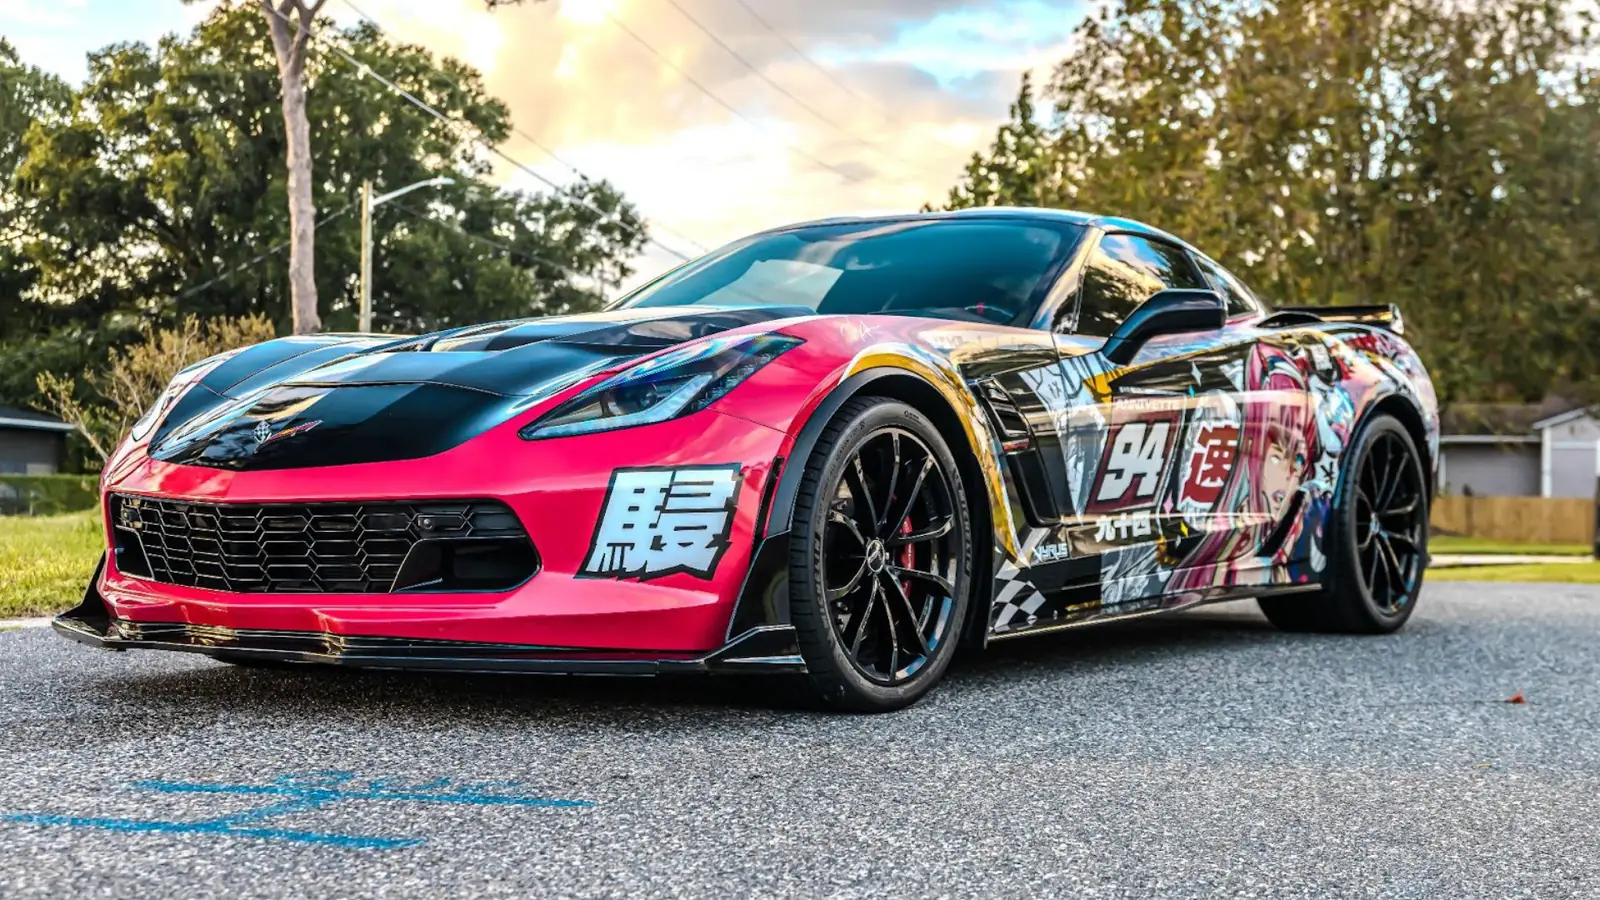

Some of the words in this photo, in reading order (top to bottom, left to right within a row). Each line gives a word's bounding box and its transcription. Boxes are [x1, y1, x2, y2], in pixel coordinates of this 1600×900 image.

[1096, 422, 1170, 501] 94
[1179, 423, 1240, 505] 速
[1094, 509, 1152, 543] 九十四
